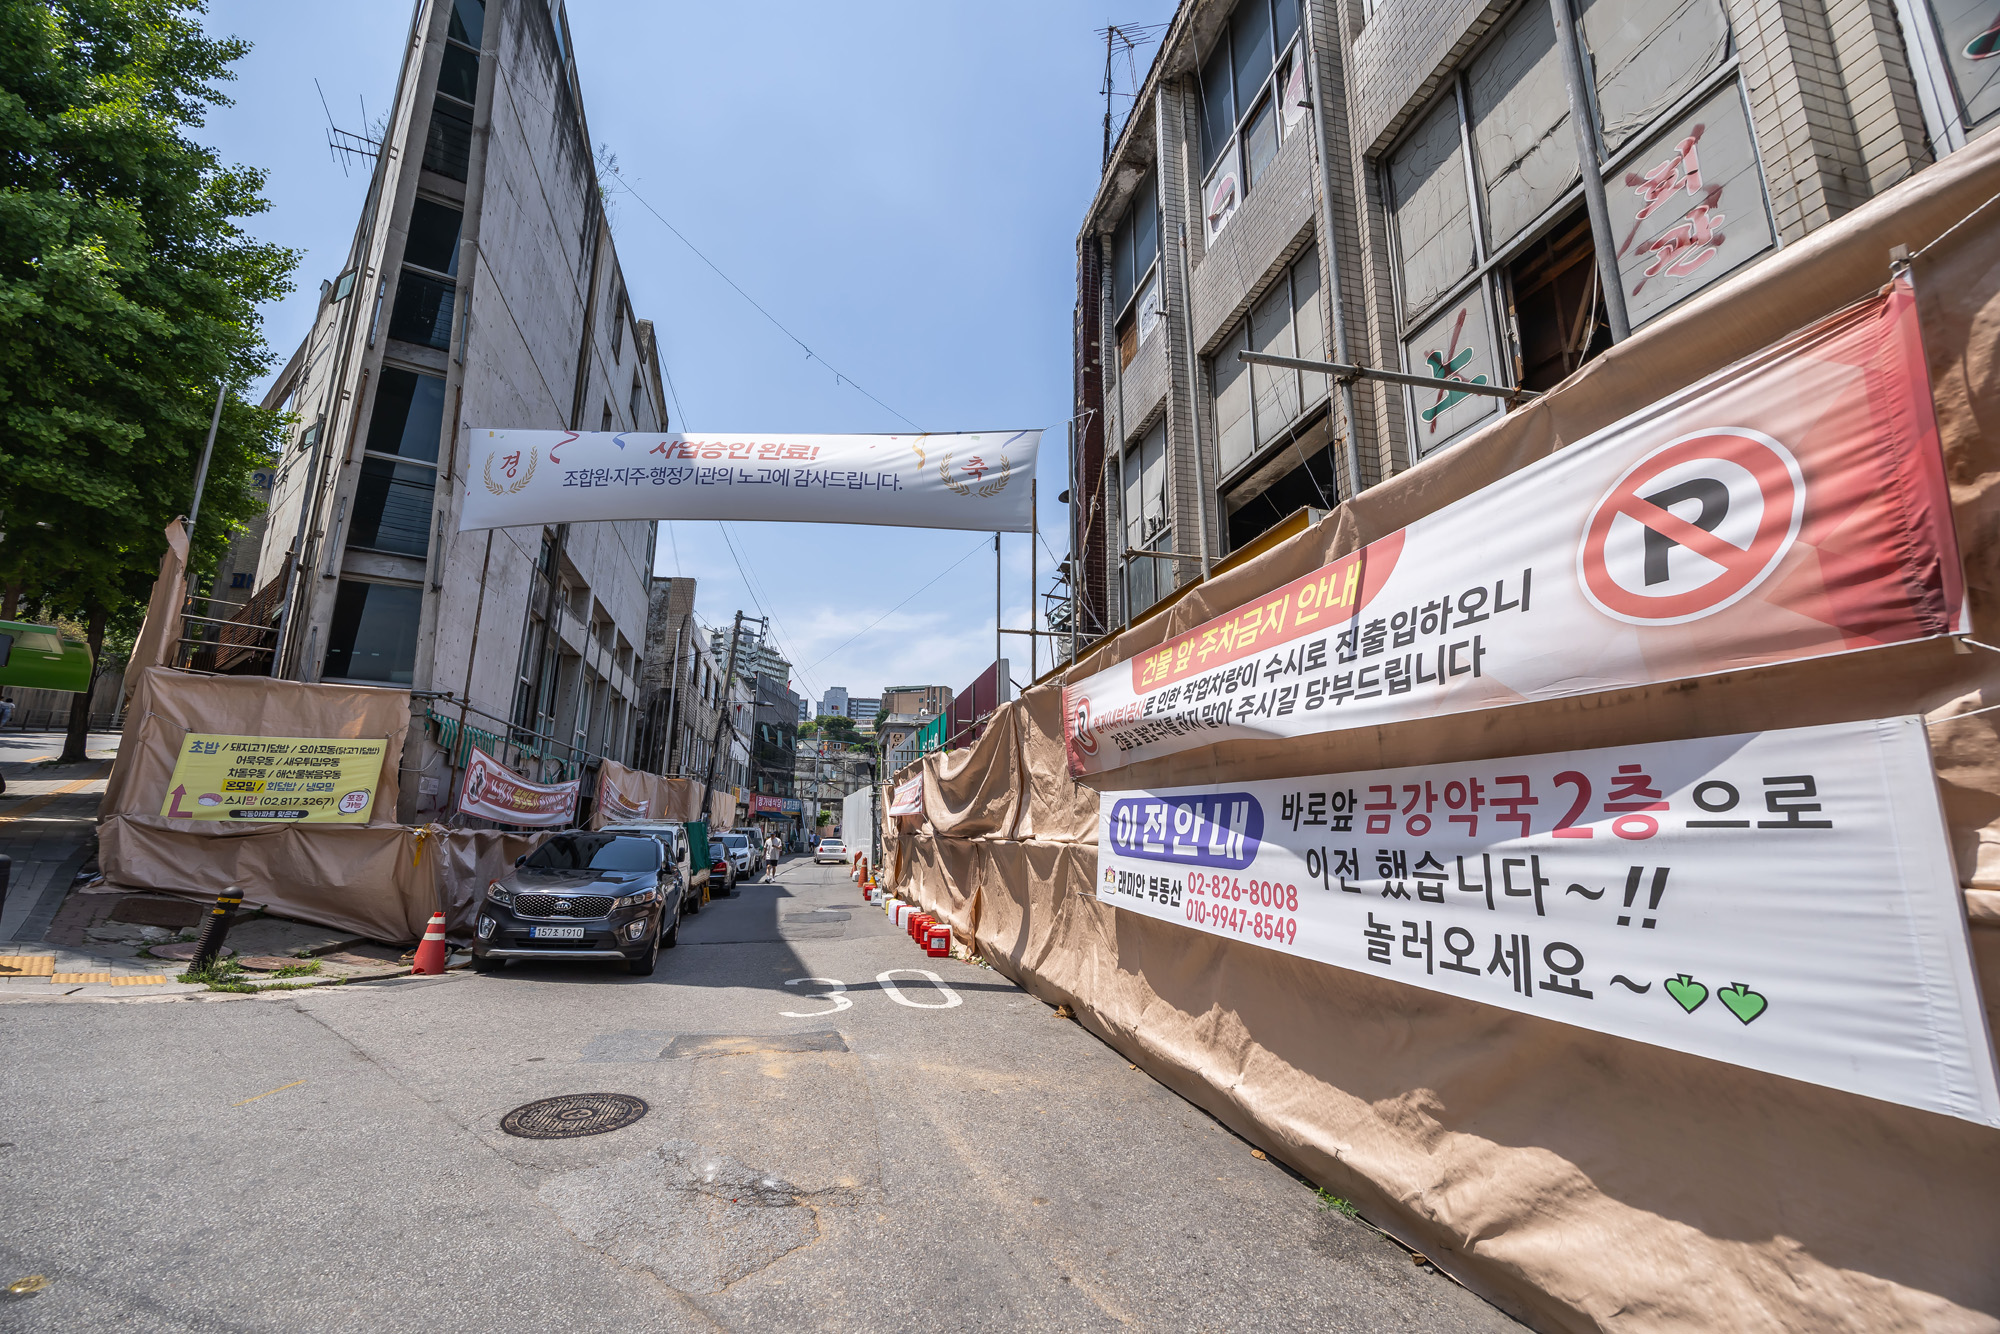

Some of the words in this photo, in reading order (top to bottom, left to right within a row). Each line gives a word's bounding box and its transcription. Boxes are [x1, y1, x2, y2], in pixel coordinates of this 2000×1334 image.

[500, 451, 521, 478] 경
[649, 441, 751, 460] 사업승인
[757, 443, 820, 461] 완료!
[737, 469, 790, 487] 노고에
[793, 469, 903, 491] 감사드립니다.
[961, 456, 988, 482] 축
[1141, 647, 1172, 687] 건물
[1174, 638, 1195, 674] 앞
[1197, 595, 1290, 663] 주차금지
[1294, 560, 1362, 626] 안내
[1157, 686, 1181, 713] 인한
[1183, 659, 1259, 704] 작업차량이
[1263, 638, 1327, 685] 수시로
[1335, 568, 1532, 664] 진출입하오니
[1202, 699, 1233, 728] 말아
[1235, 684, 1299, 724] 주시길
[1305, 634, 1486, 710] 당부드립니다
[188, 740, 220, 755] 초밥
[230, 743, 290, 753] 돼지고기덮밥
[236, 756, 275, 766] 어묵우동
[283, 757, 340, 767] 새우튀김우동
[266, 781, 297, 792] 회덮밥
[306, 782, 335, 792] 냉모밀
[224, 795, 258, 806] 스시맘
[1282, 789, 1357, 832] 바로앞
[1117, 801, 1249, 860] 이전안내
[1306, 847, 1361, 894] 이전
[1118, 871, 1145, 899] 래미안
[1149, 876, 1182, 907] 부동산
[1188, 871, 1299, 912] 02-826-8008
[562, 928, 582, 938] 1910
[1186, 899, 1297, 945] 010-9947-8549
